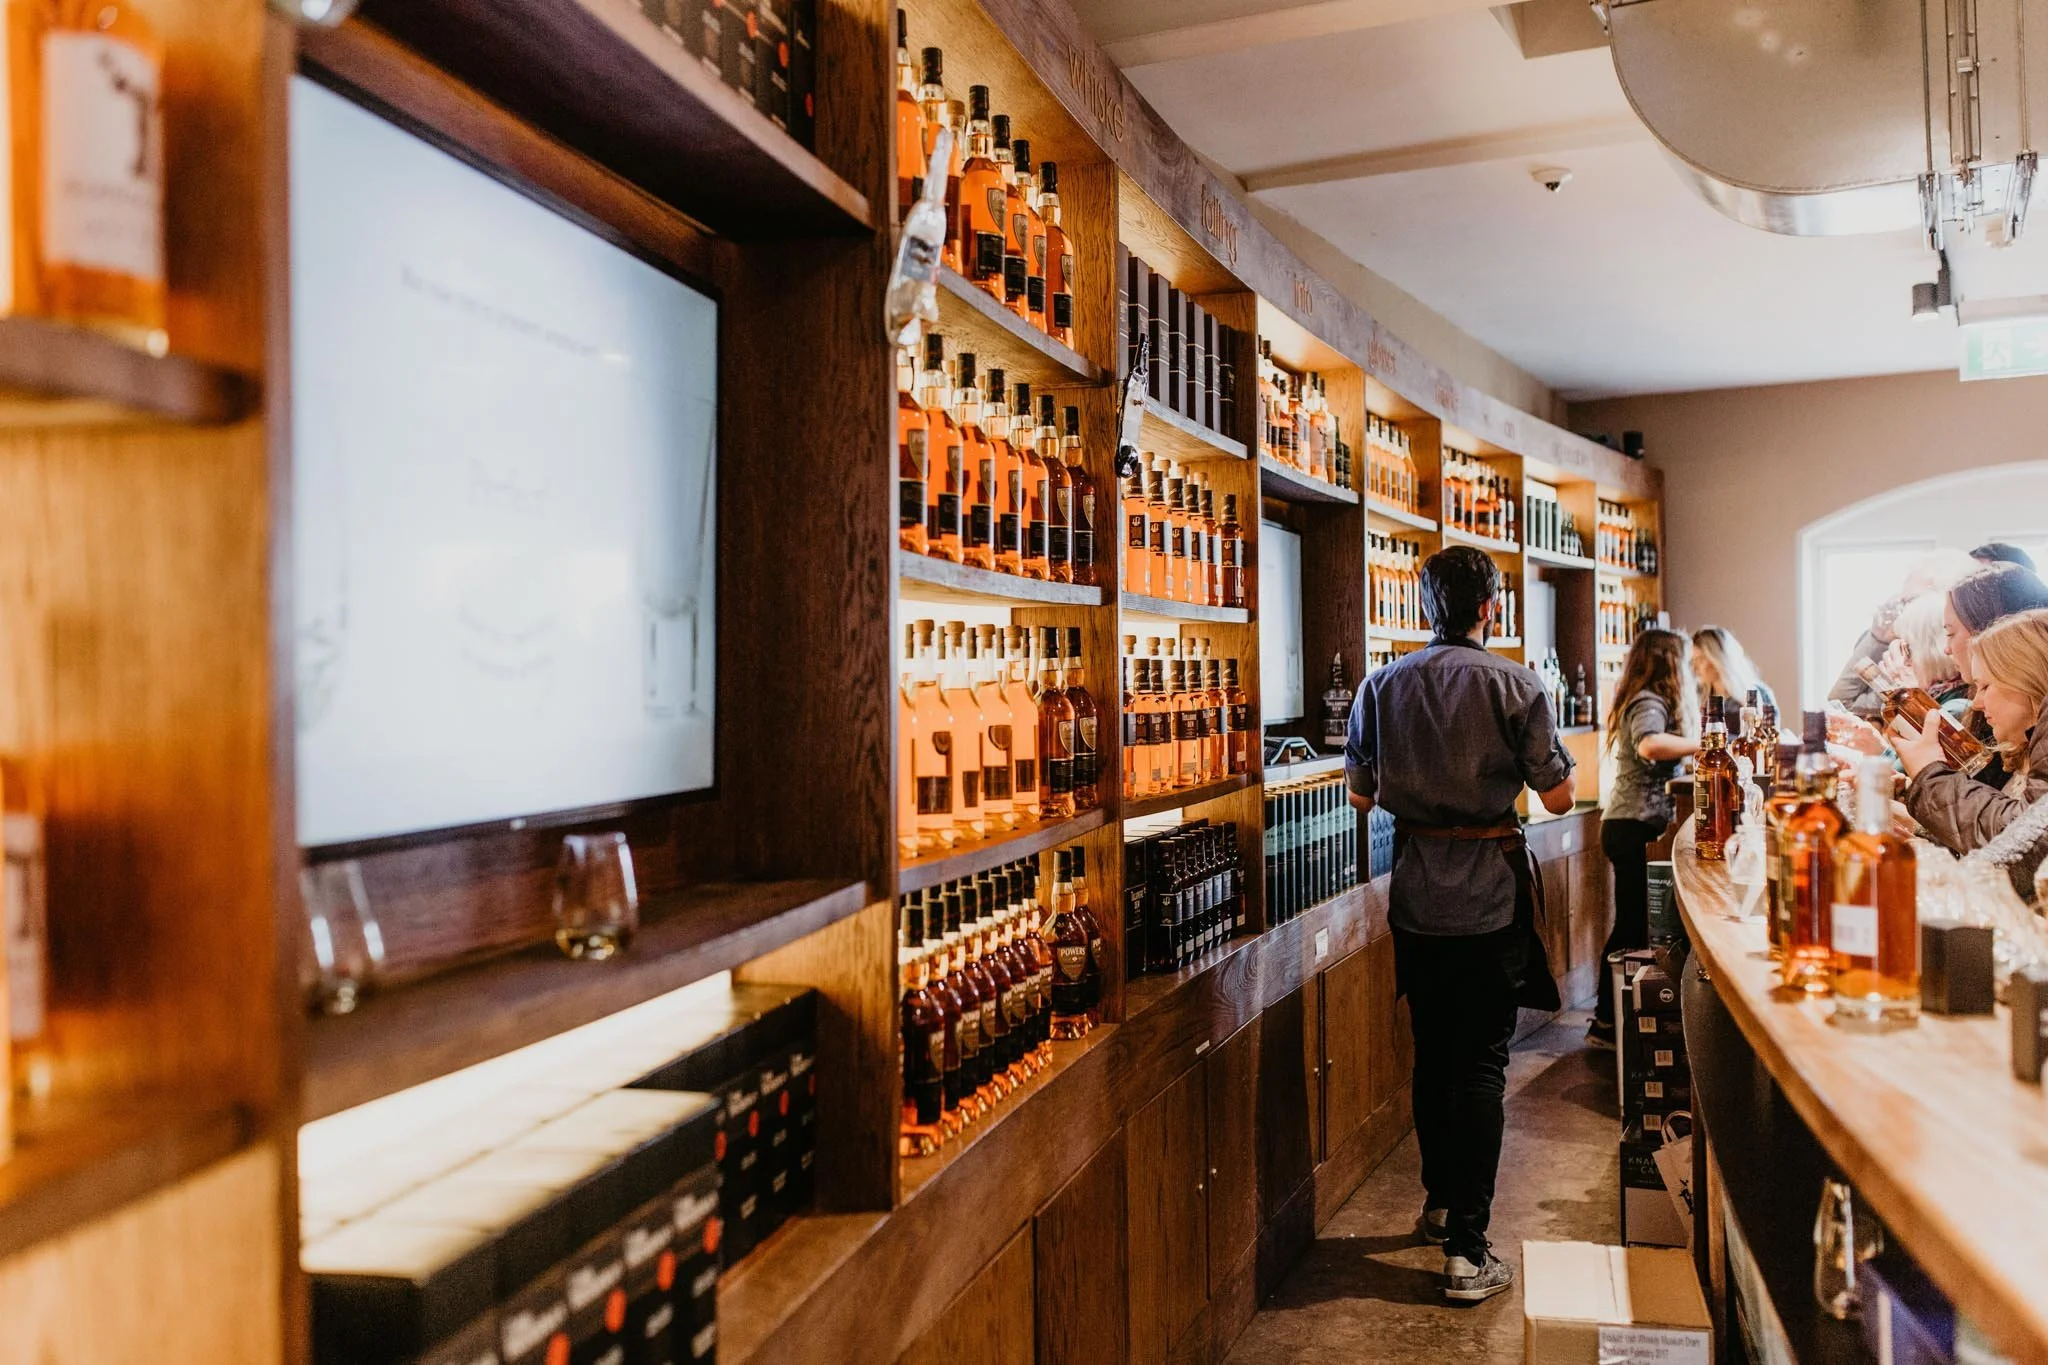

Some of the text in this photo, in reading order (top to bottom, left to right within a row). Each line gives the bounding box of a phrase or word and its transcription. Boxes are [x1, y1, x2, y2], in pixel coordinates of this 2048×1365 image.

[1201, 182, 1238, 266] falling
[1293, 272, 1313, 317] into
[1060, 946, 1086, 957] POWERS
